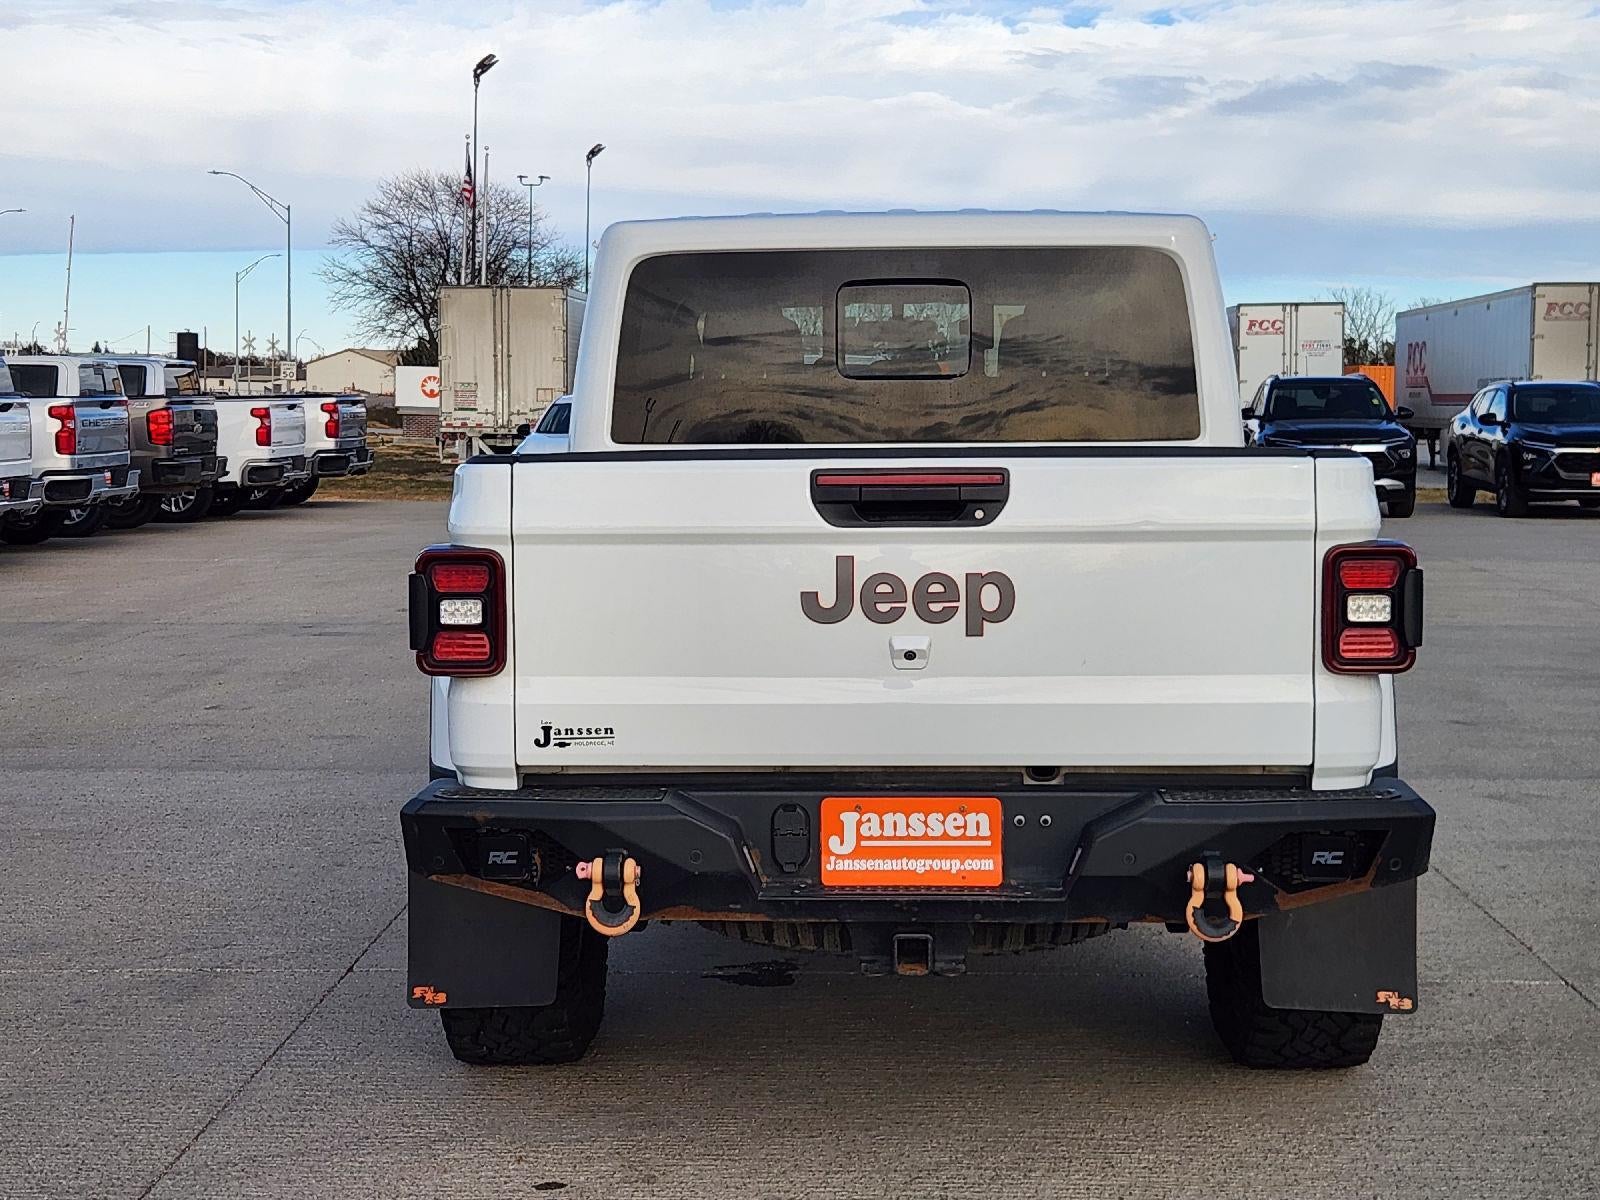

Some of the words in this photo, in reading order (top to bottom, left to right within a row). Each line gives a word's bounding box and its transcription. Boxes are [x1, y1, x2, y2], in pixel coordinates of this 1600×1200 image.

[1545, 302, 1590, 316] FCC
[1247, 320, 1285, 331] FCC
[1406, 341, 1427, 376] FCC
[800, 555, 1016, 637] Jeep
[533, 725, 615, 748] Janssen
[828, 811, 991, 855] Janssen
[488, 851, 518, 864] RC
[826, 855, 994, 874] Janssenautogroup.com
[1312, 851, 1345, 864] RC
